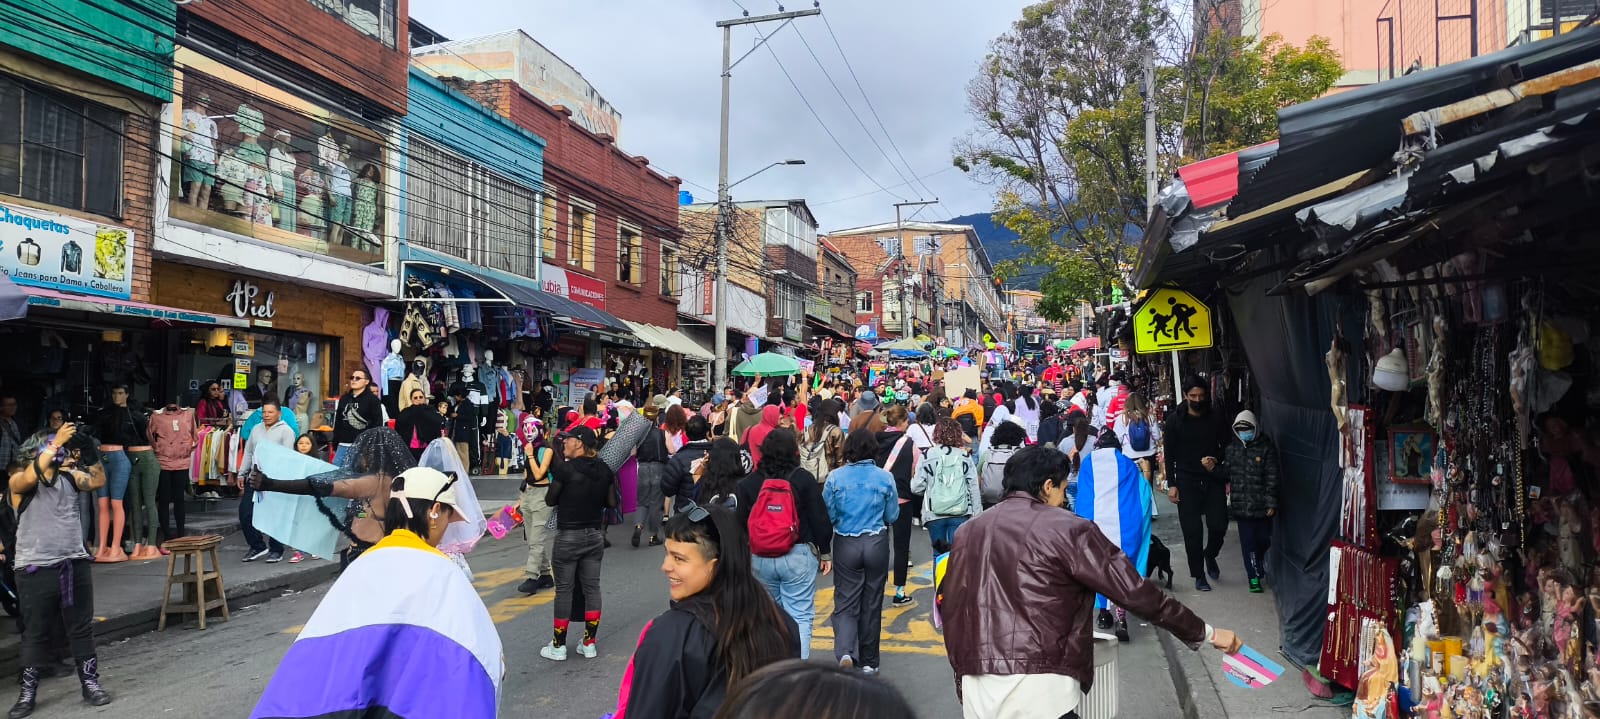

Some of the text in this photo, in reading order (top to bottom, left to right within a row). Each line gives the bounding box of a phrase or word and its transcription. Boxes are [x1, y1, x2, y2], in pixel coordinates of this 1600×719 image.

[0, 205, 70, 235] Chaquetas
[14, 268, 37, 280] Jeans
[39, 274, 58, 283] para
[60, 275, 82, 287] Dama
[90, 280, 124, 293] Caballero
